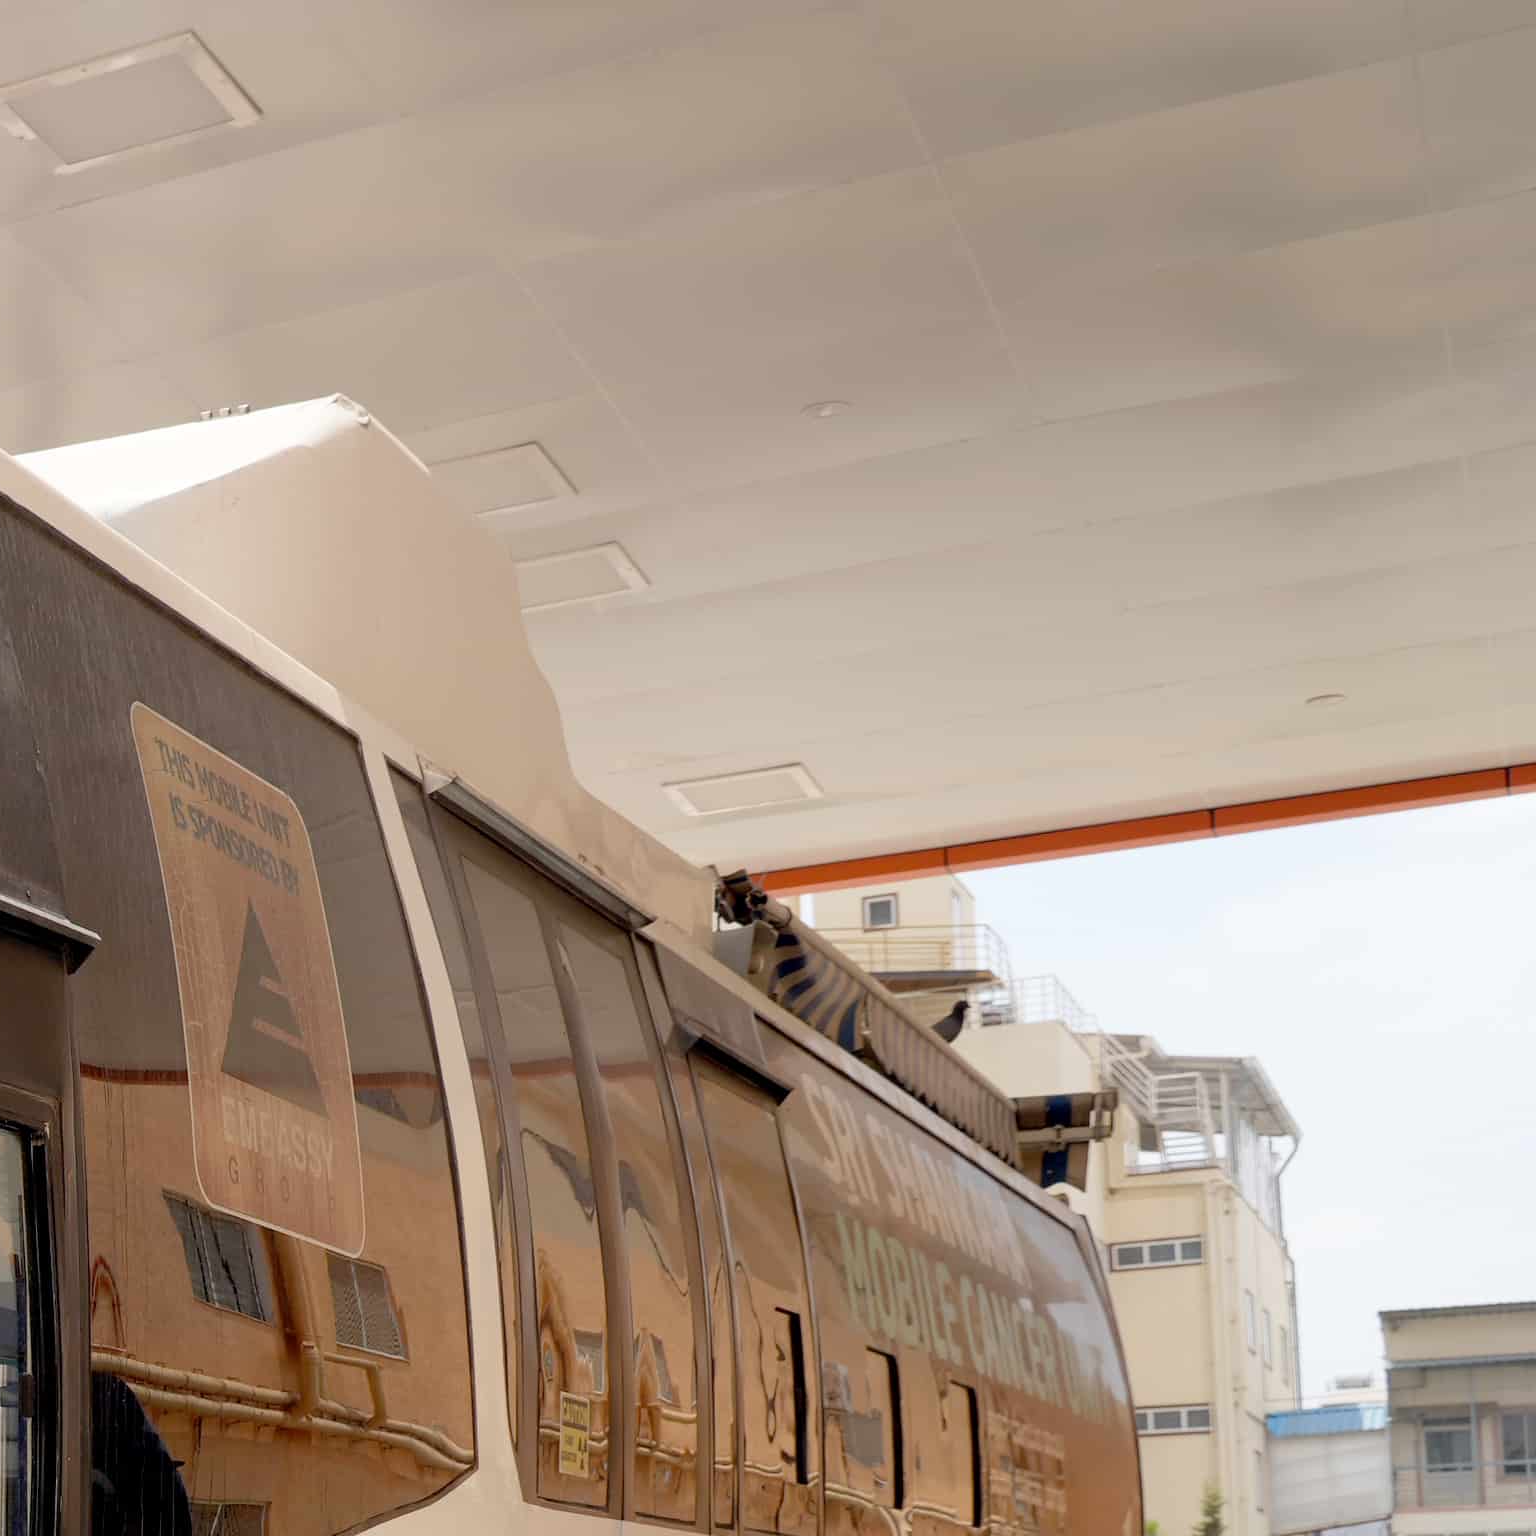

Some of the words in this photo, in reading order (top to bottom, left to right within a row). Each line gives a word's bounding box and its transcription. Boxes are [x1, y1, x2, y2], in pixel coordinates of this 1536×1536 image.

[154, 736, 195, 789] THIS
[194, 761, 256, 825] MOBILE
[254, 799, 291, 847] UNIT
[169, 792, 187, 830] IS
[187, 803, 280, 886] SPONSORED
[800, 1072, 879, 1206] SRI
[834, 1211, 962, 1365] MOBILE
[959, 1275, 1066, 1400] CANCER
